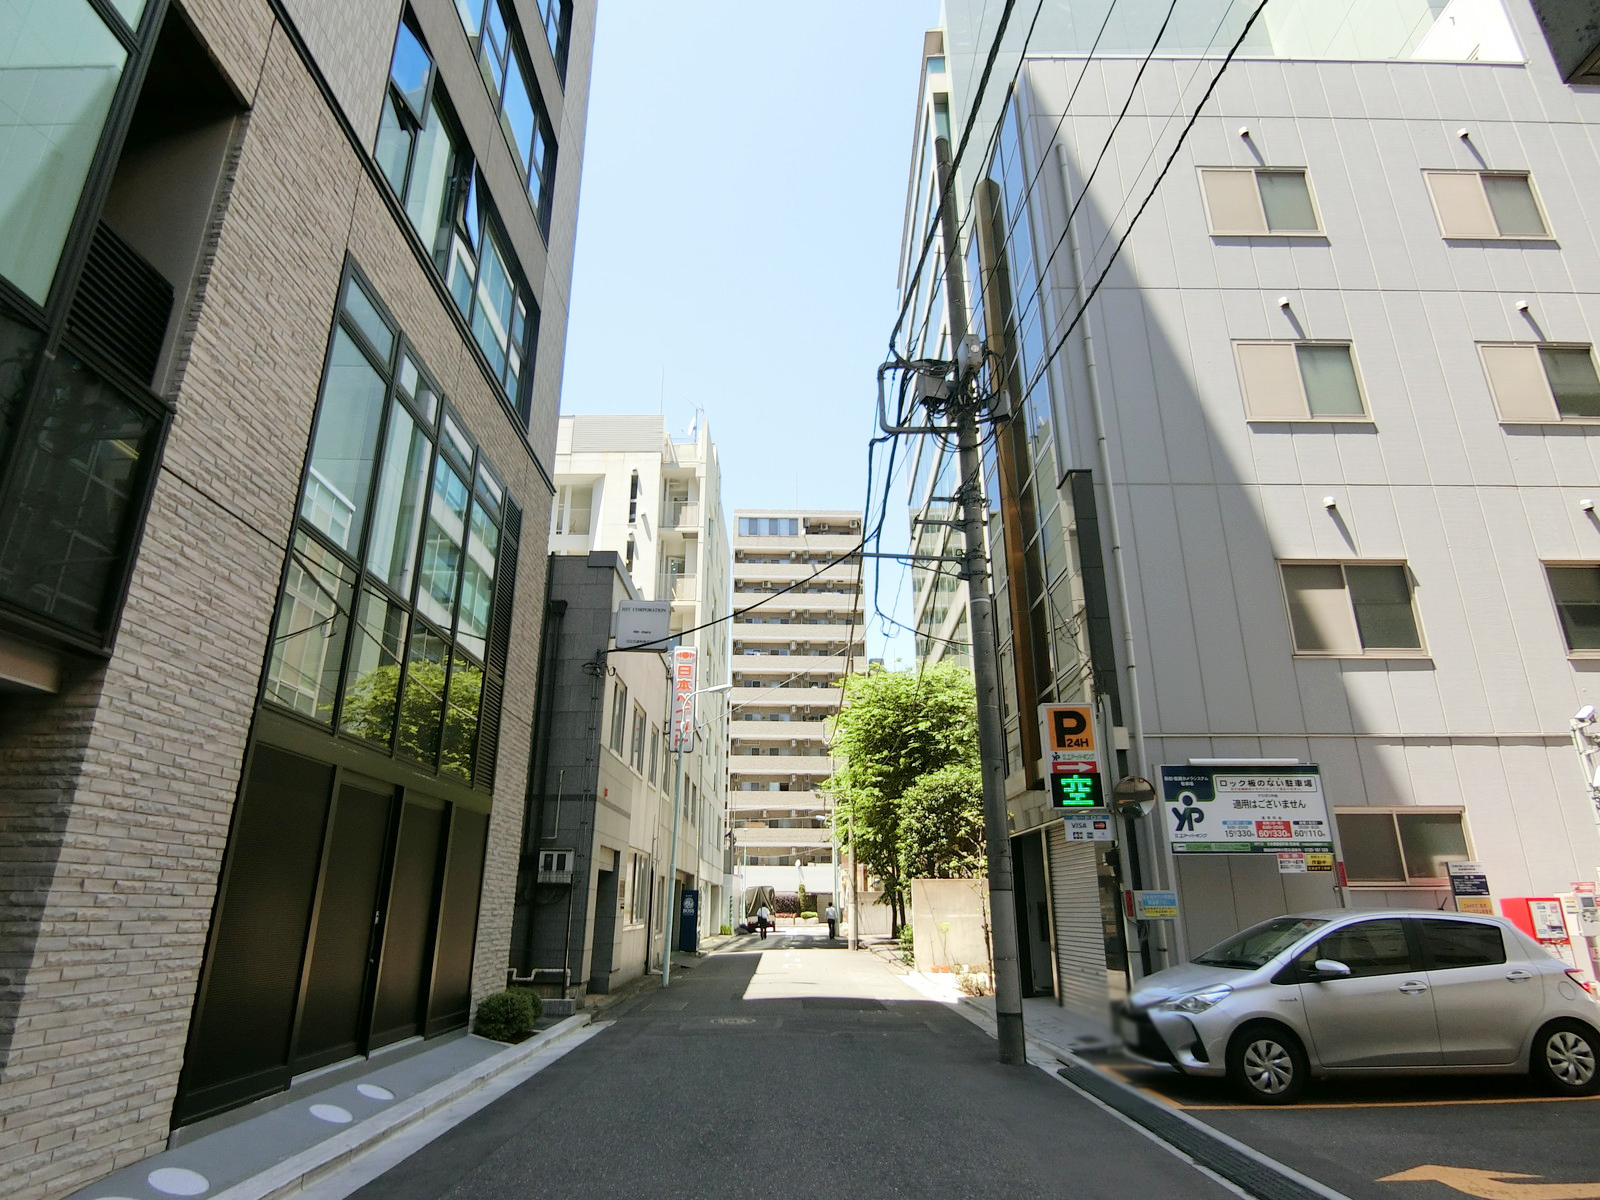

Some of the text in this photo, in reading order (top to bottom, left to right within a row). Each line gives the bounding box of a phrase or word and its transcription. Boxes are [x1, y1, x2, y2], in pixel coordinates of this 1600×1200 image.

[1054, 710, 1086, 748] P
[1067, 738, 1089, 747] 24H
[1220, 779, 1313, 788] ロック板のない駐車場
[1060, 774, 1094, 805] 空
[1232, 799, 1307, 809] 適用はございません
